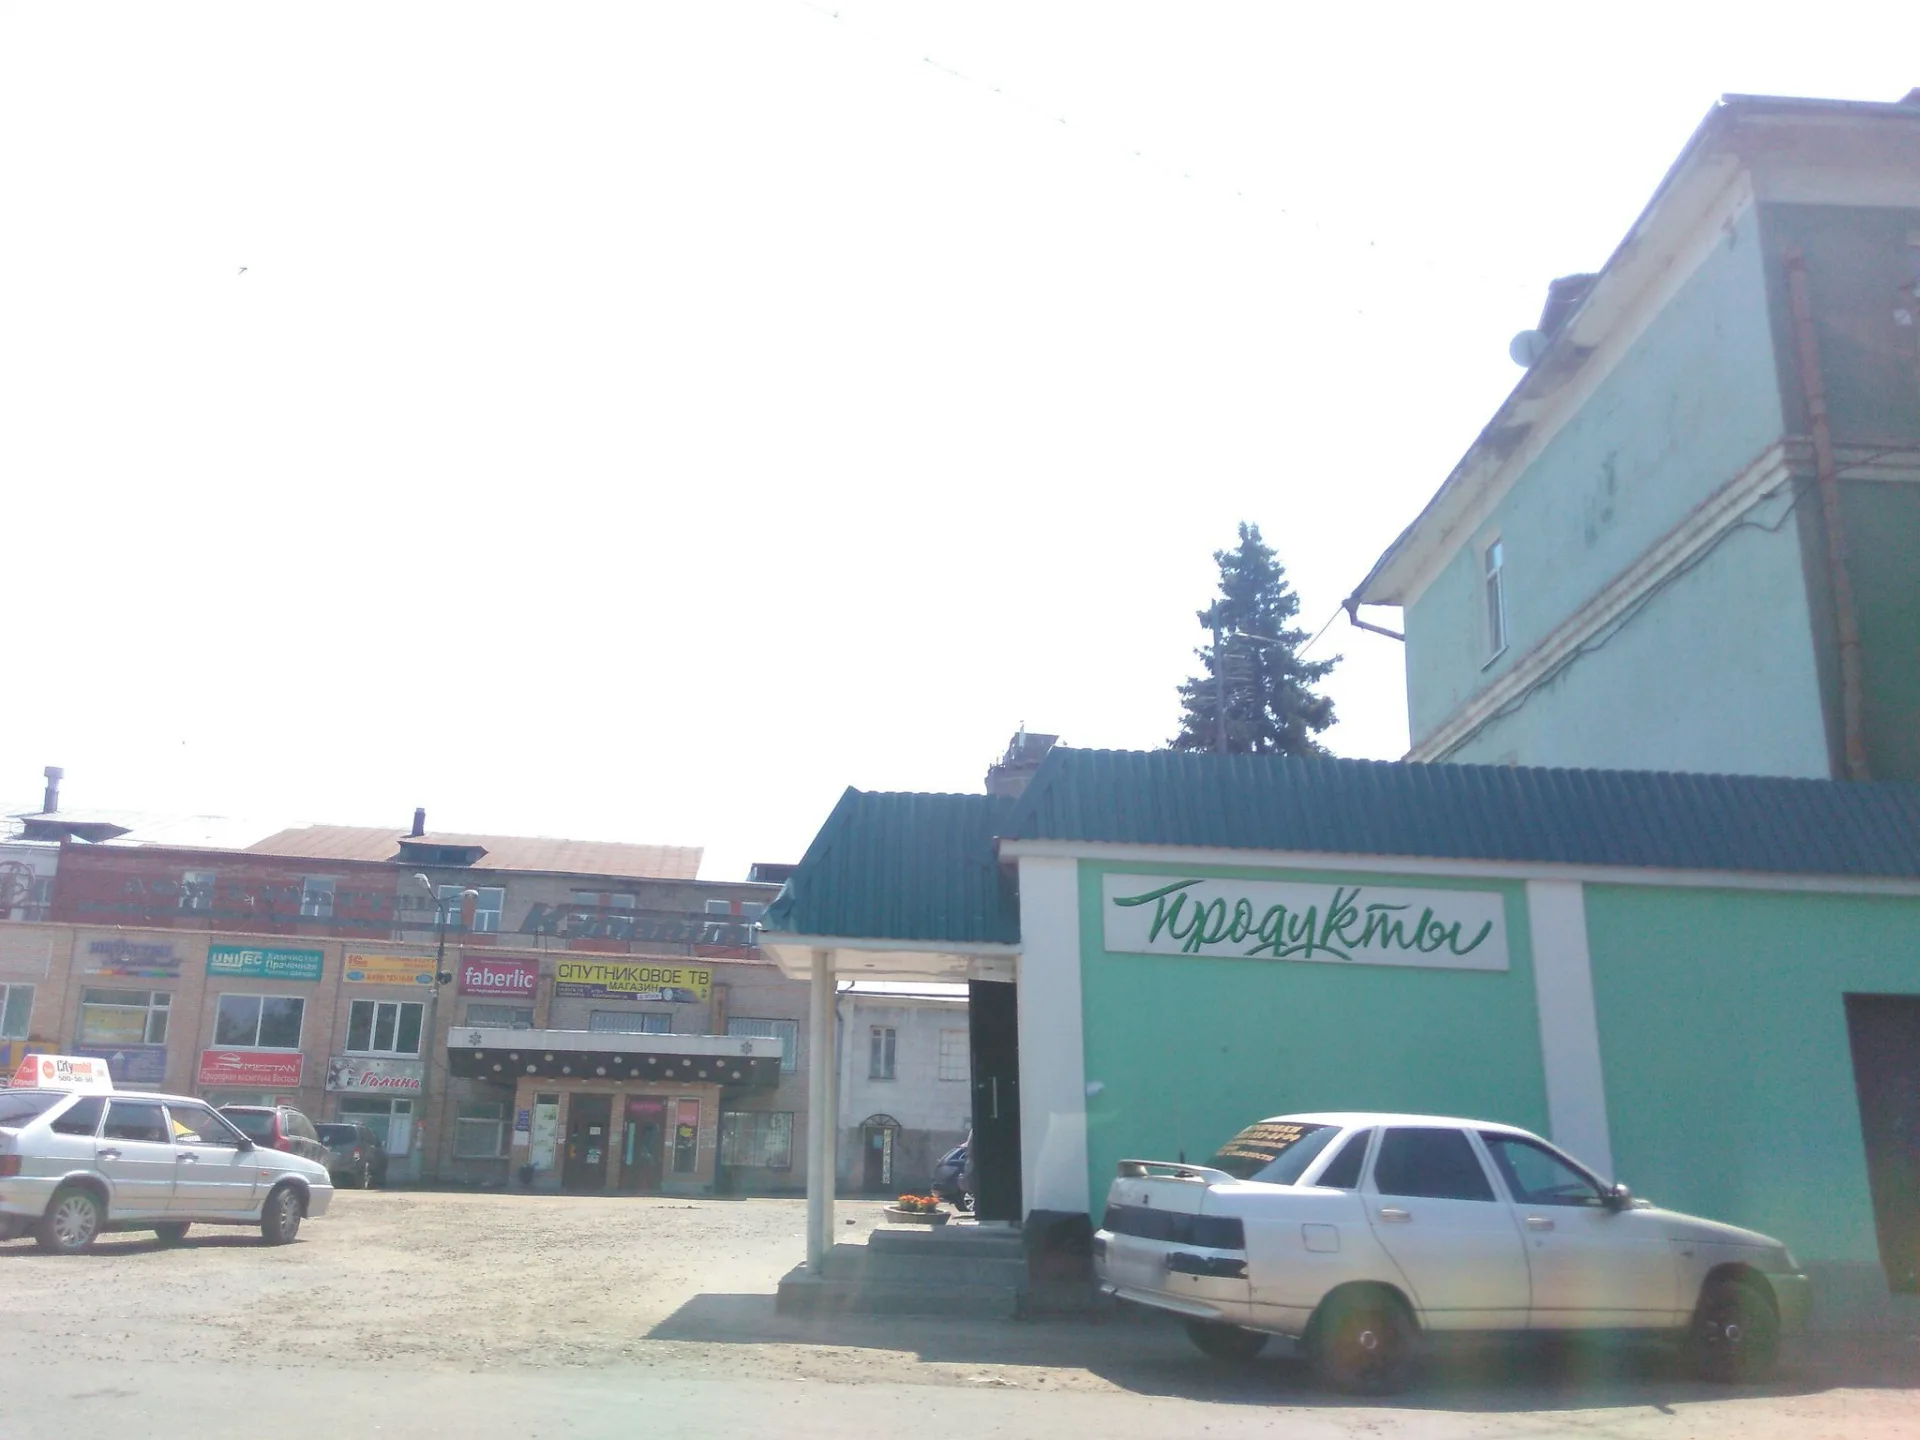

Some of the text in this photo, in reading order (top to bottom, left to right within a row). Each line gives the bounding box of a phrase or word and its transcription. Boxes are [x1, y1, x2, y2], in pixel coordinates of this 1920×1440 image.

[1113, 878, 1492, 961] Продукты
[265, 960, 317, 971] Прачечная
[558, 964, 710, 985] СПУТНИКОВОЕ ТВ
[465, 966, 533, 988] faberlic
[608, 981, 659, 992] МАГАЗИН
[360, 1071, 421, 1090] Галина
